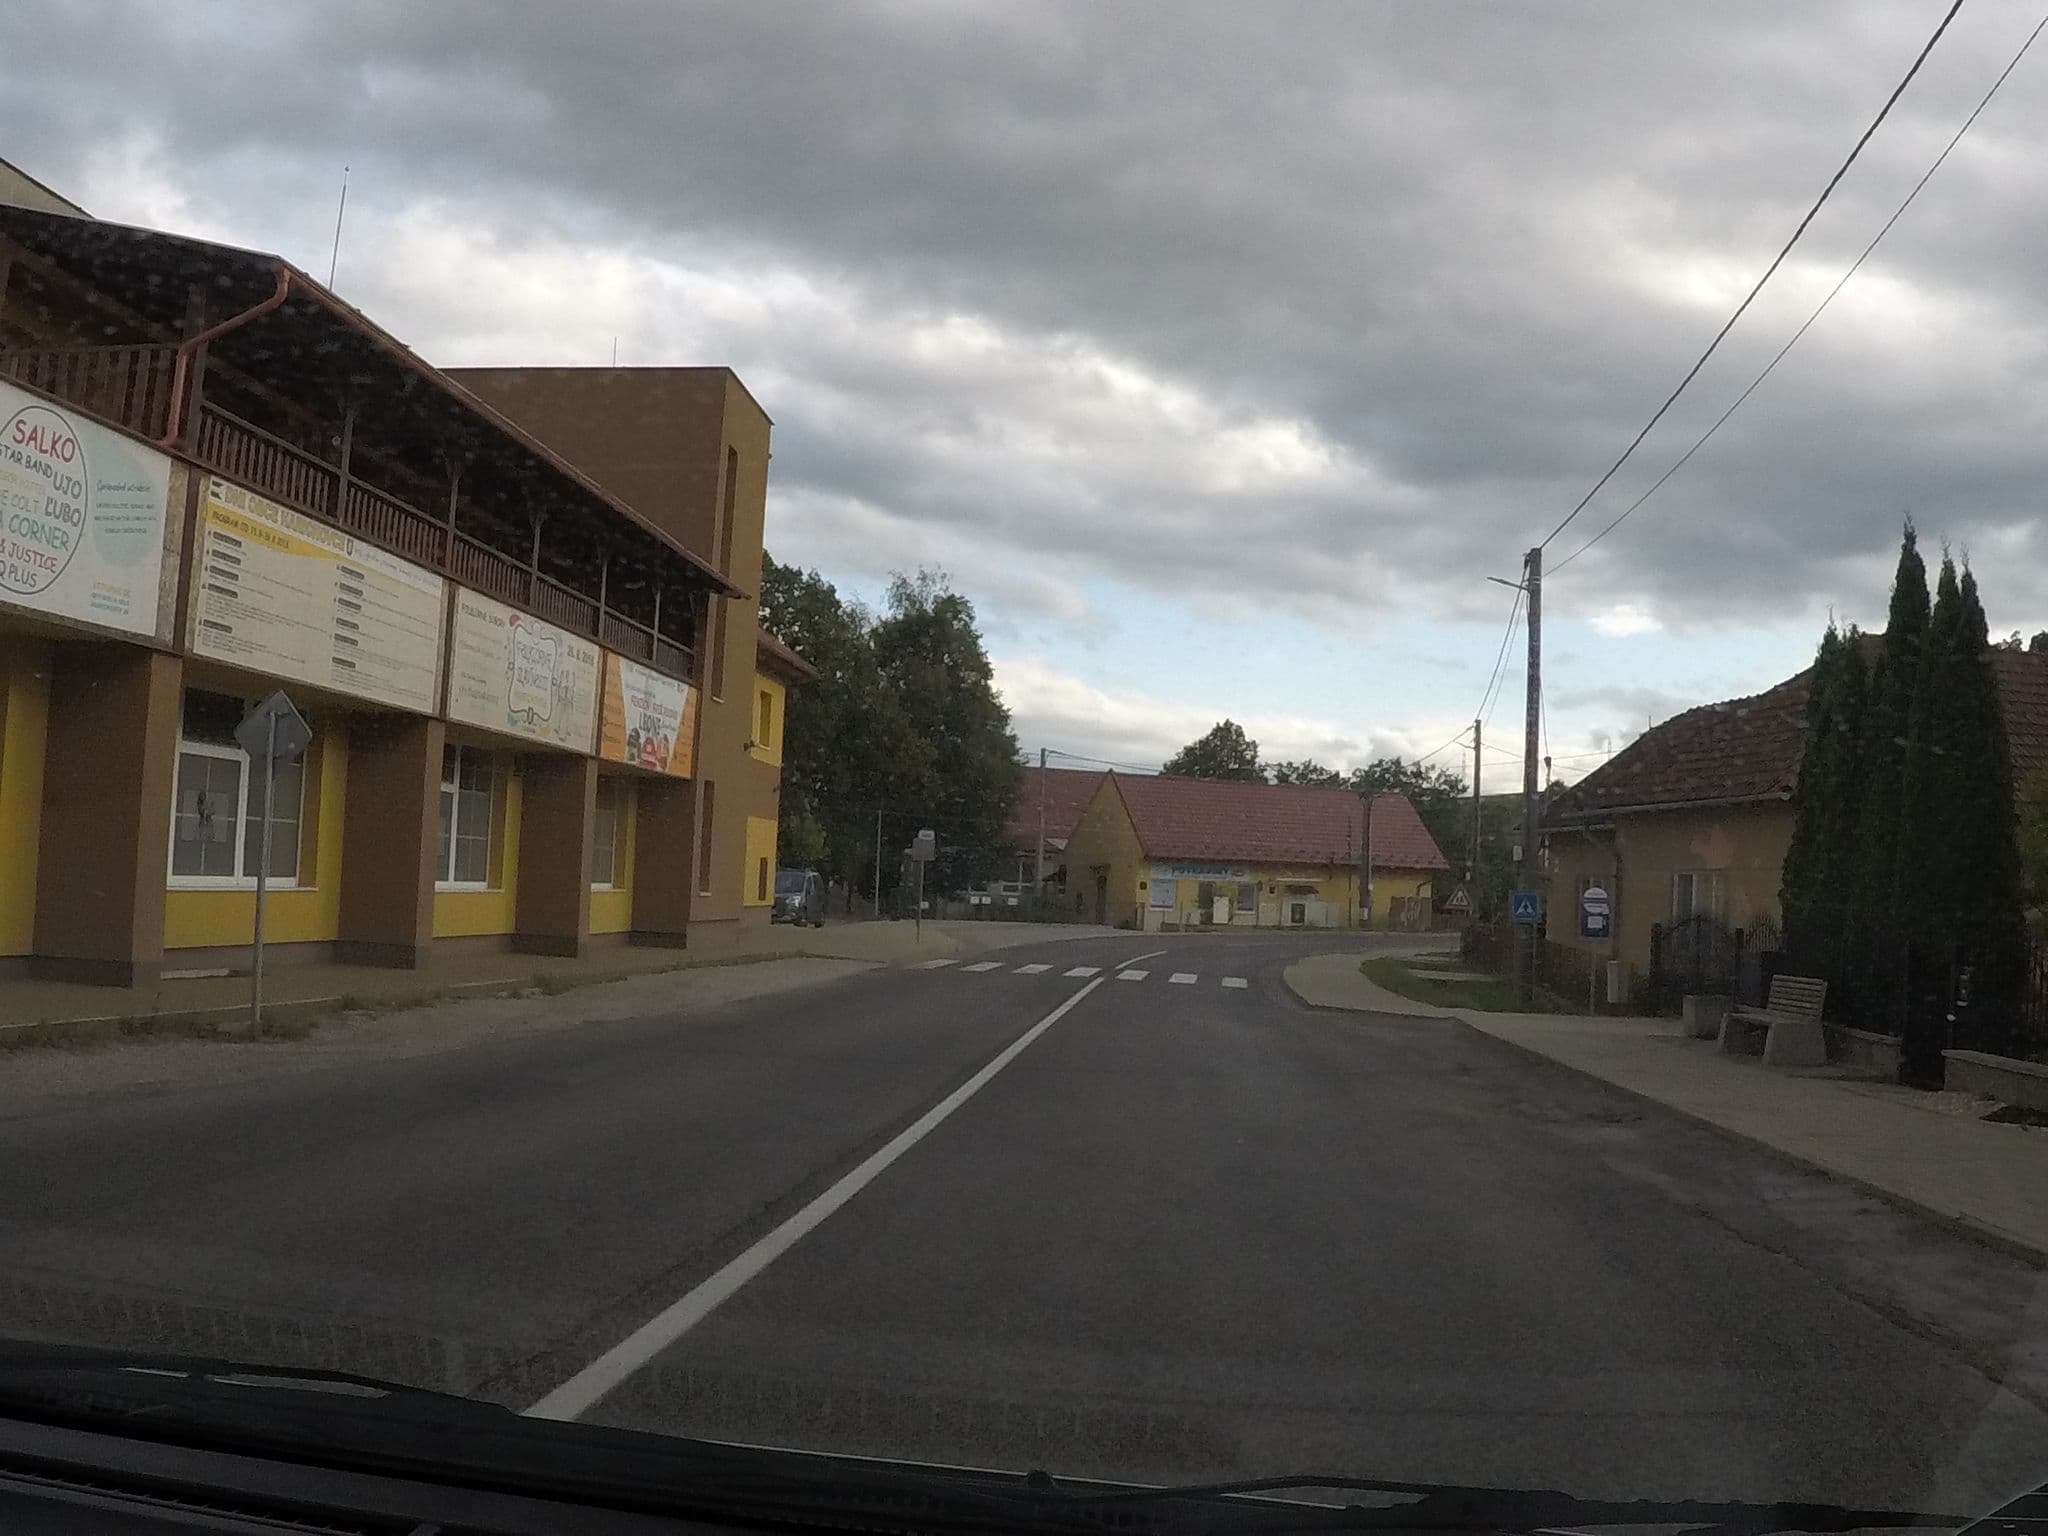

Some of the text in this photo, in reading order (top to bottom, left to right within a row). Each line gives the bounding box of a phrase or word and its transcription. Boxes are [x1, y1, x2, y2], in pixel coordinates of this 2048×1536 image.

[13, 418, 76, 463] SALKO
[0, 442, 24, 465] TAR
[25, 454, 53, 479] BAND
[52, 471, 82, 500] UJO
[8, 513, 71, 552] CORNER
[8, 542, 58, 574] JUSTICE
[8, 563, 38, 588] PLUS
